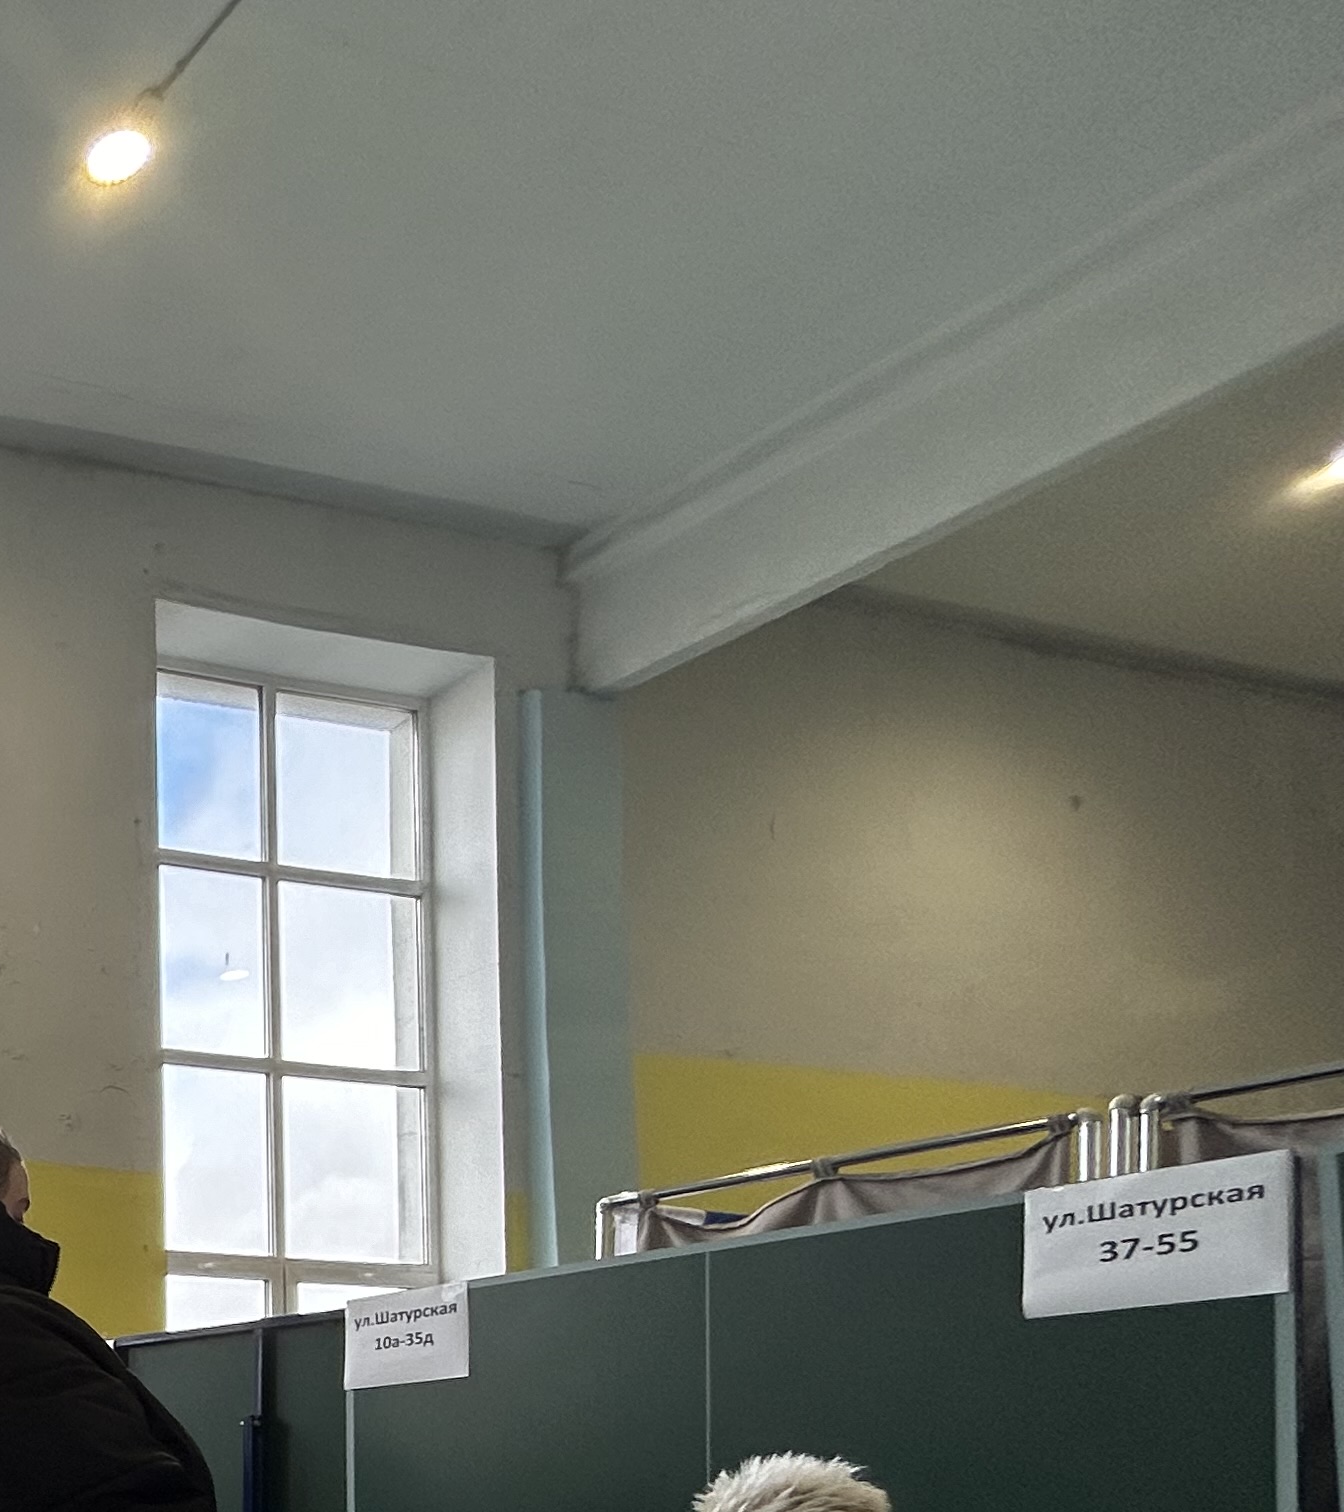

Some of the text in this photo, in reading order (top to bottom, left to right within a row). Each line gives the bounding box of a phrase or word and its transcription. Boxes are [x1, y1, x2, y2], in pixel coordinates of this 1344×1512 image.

[1043, 1184, 1265, 1234] ул.Шатурская
[1099, 1230, 1199, 1263] 37-55
[354, 1303, 458, 1332] ул.Шатурская
[375, 1331, 435, 1351] 10а-35д
